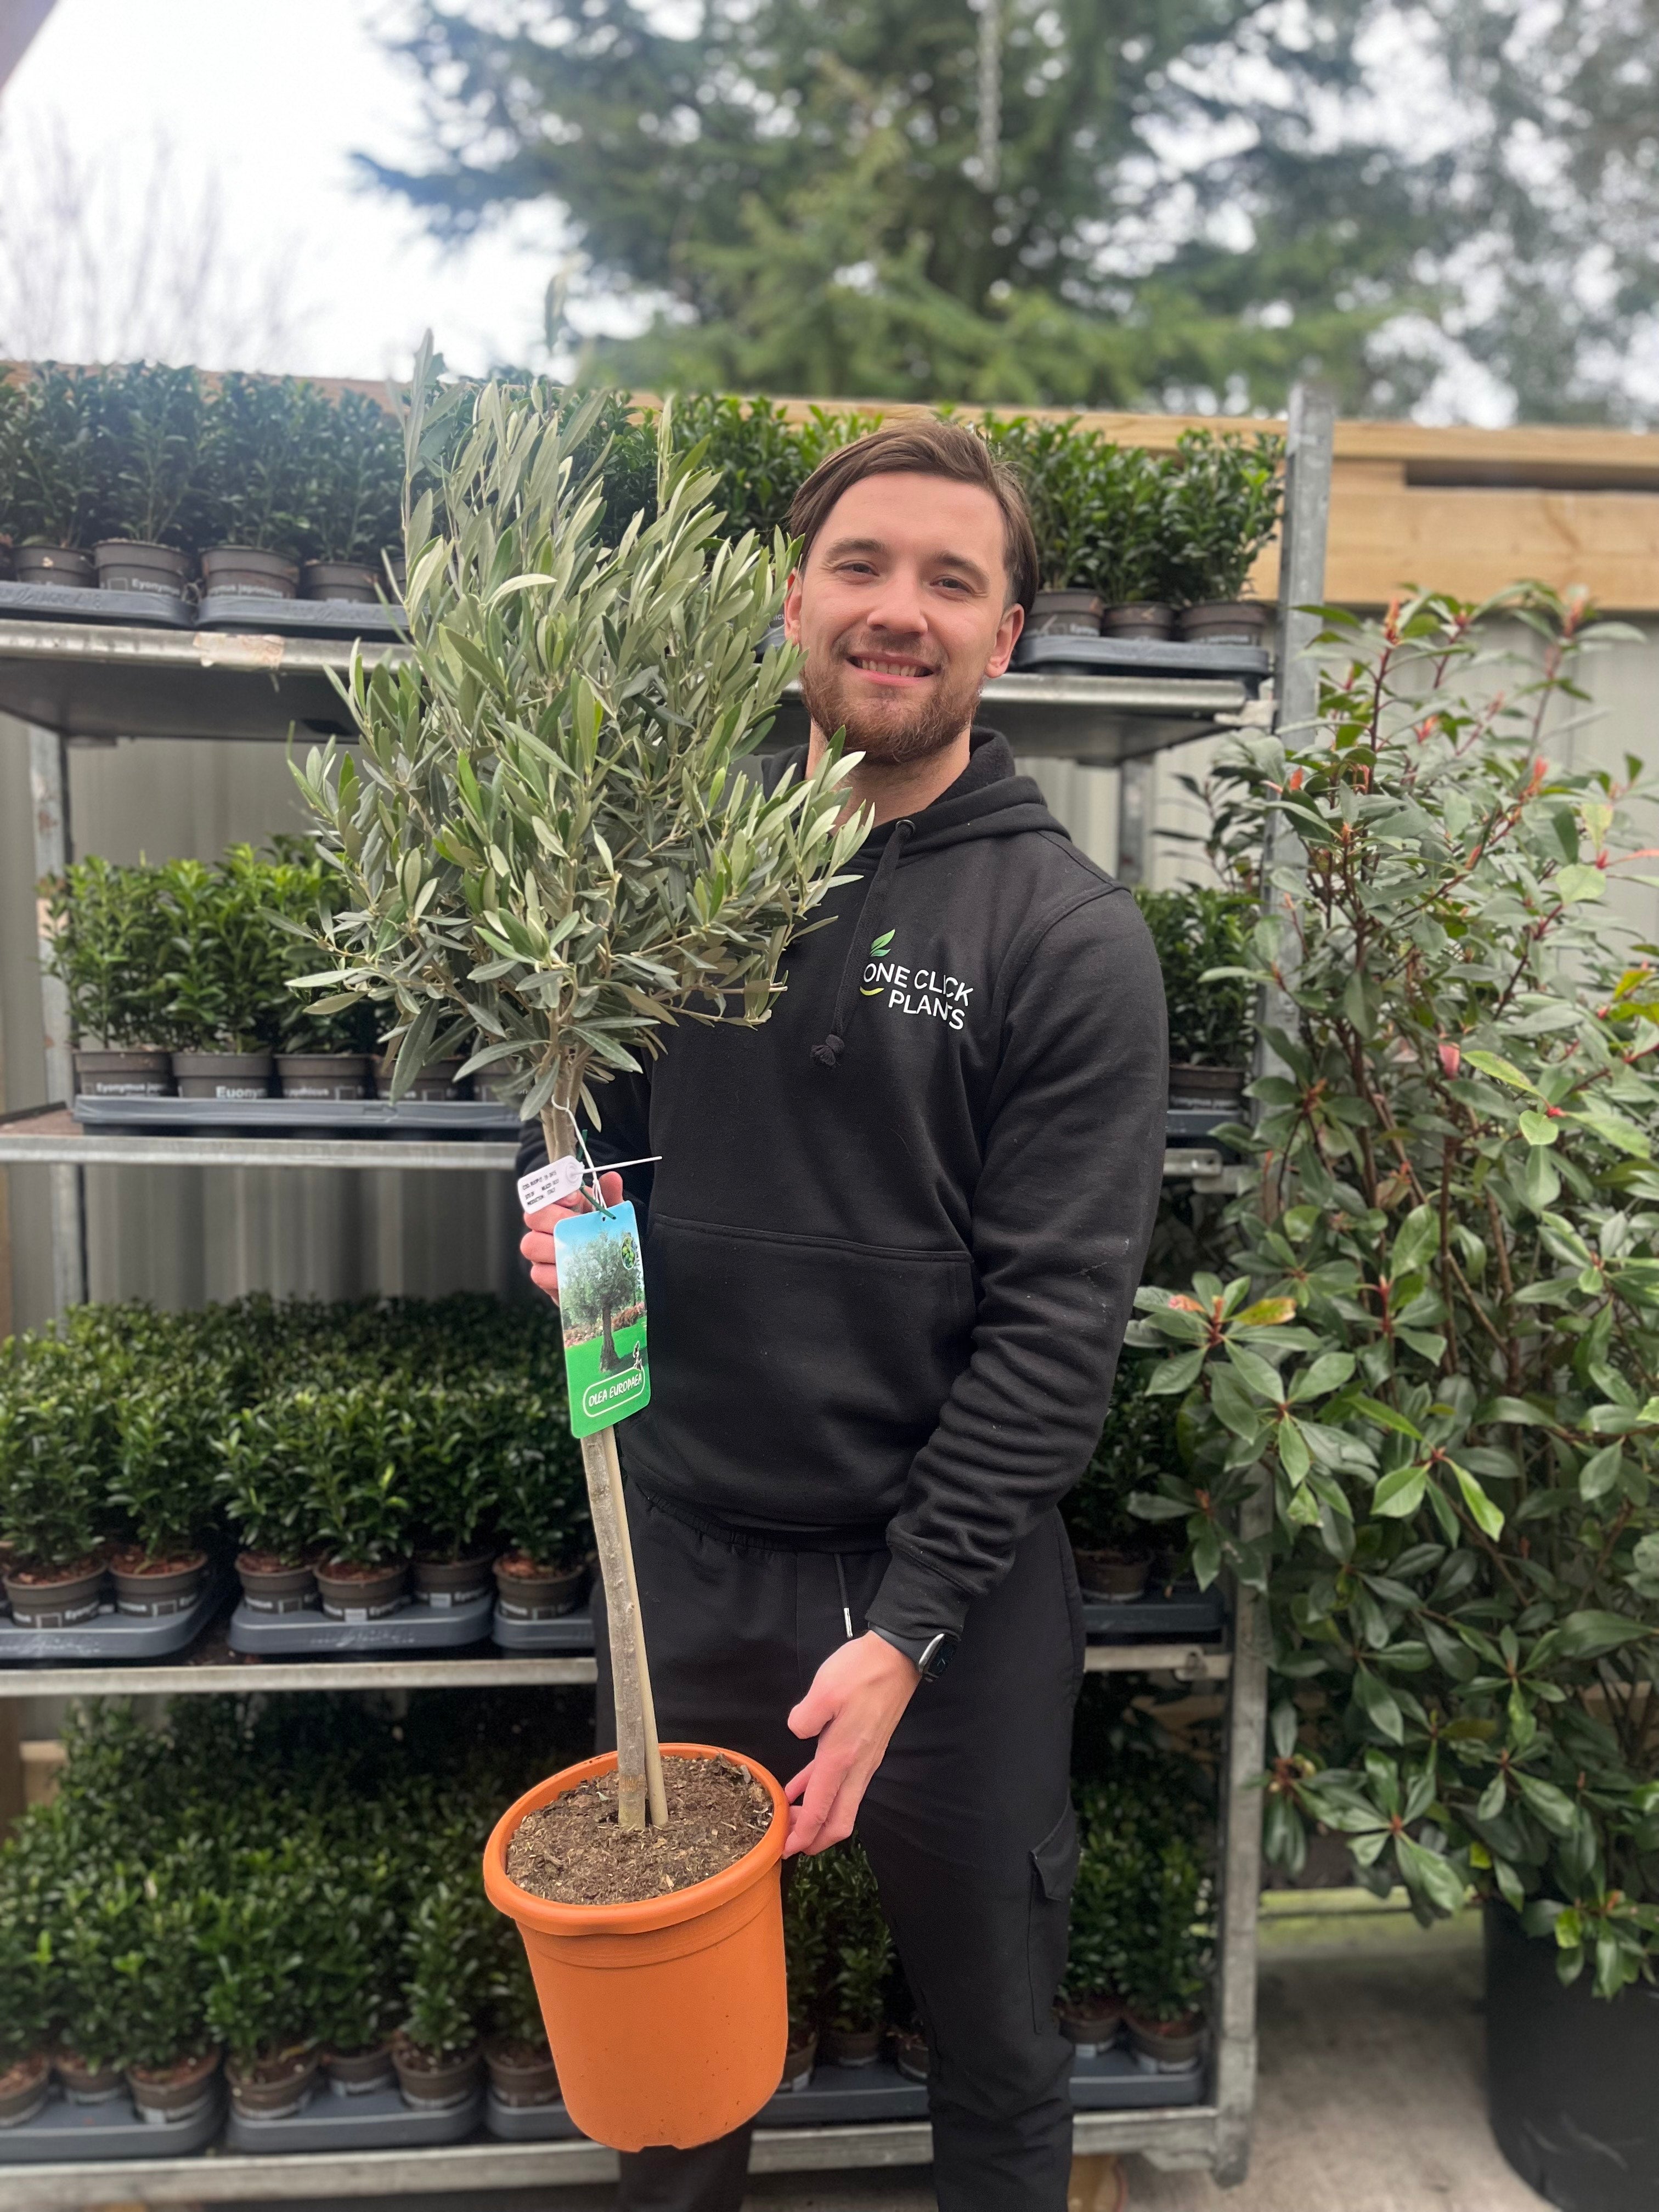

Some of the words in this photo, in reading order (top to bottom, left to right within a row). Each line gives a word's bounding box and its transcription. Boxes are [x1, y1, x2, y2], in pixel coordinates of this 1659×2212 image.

[863, 962, 911, 988] ONE
[914, 969, 974, 1007] CLICK
[588, 1389, 608, 1407] OLEA
[609, 1372, 642, 1399] EUROPAEA
